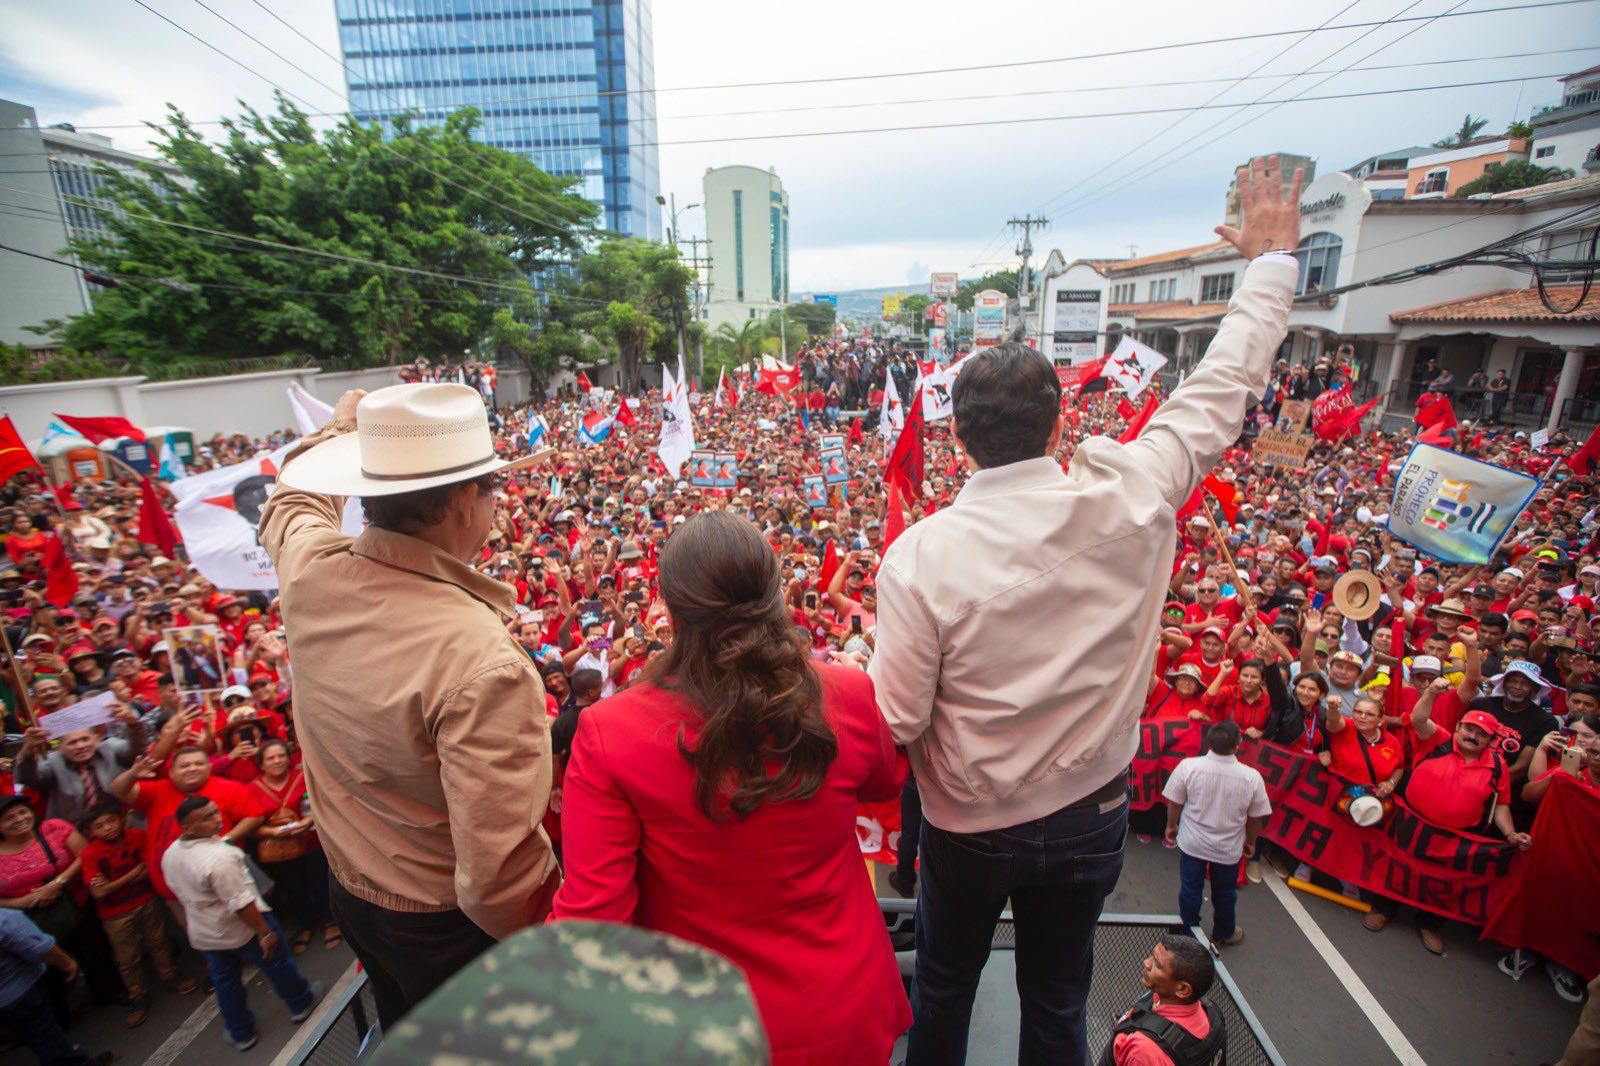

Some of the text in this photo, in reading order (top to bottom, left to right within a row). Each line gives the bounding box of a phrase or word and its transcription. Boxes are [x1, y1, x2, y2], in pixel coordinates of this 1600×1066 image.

[1406, 463, 1420, 474] EL
[1405, 469, 1438, 525] PROHECO
[1135, 721, 1190, 760] DE
[1360, 839, 1489, 923] YORO
